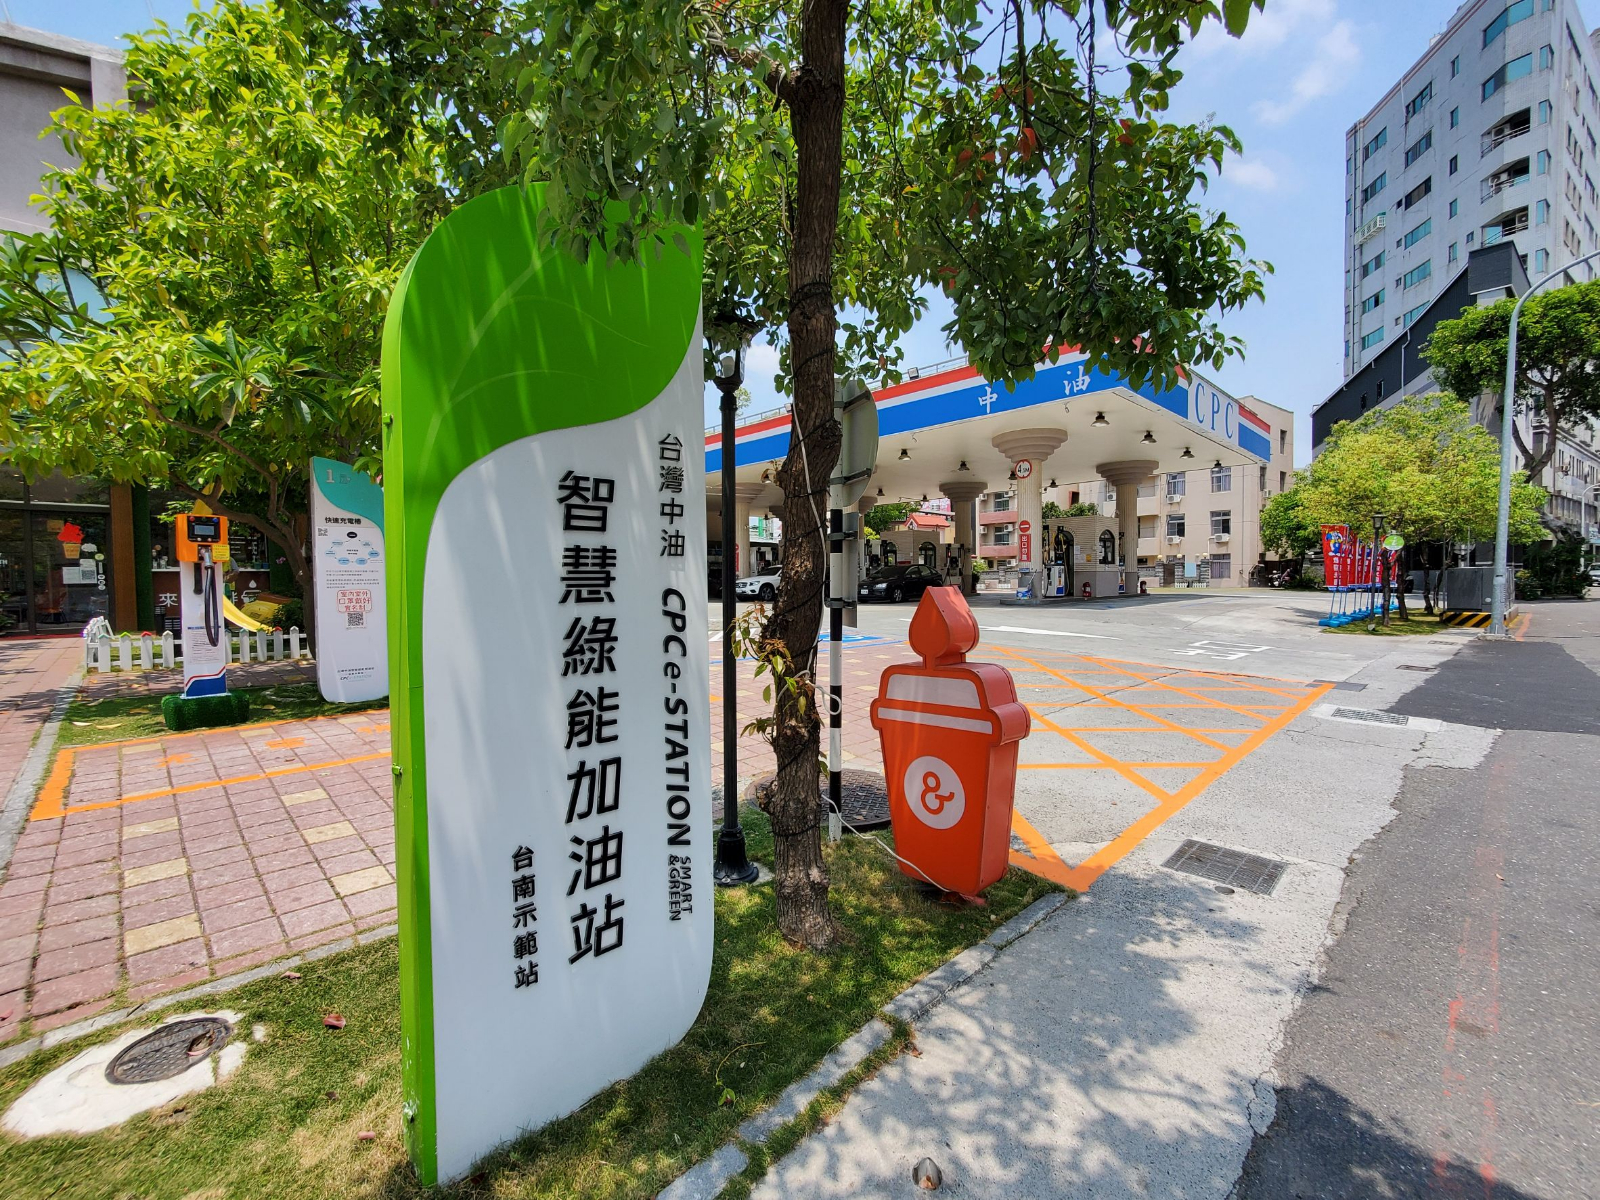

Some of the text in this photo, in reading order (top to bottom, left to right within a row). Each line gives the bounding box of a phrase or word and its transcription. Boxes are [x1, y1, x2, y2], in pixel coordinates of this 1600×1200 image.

[1194, 382, 1235, 440] CPC
[658, 433, 686, 558] 台灣中油
[556, 469, 625, 965] 智慧綠能加油站
[511, 844, 539, 989] 台南示範站
[668, 854, 682, 922] &GREEN
[680, 855, 693, 914] SMART
